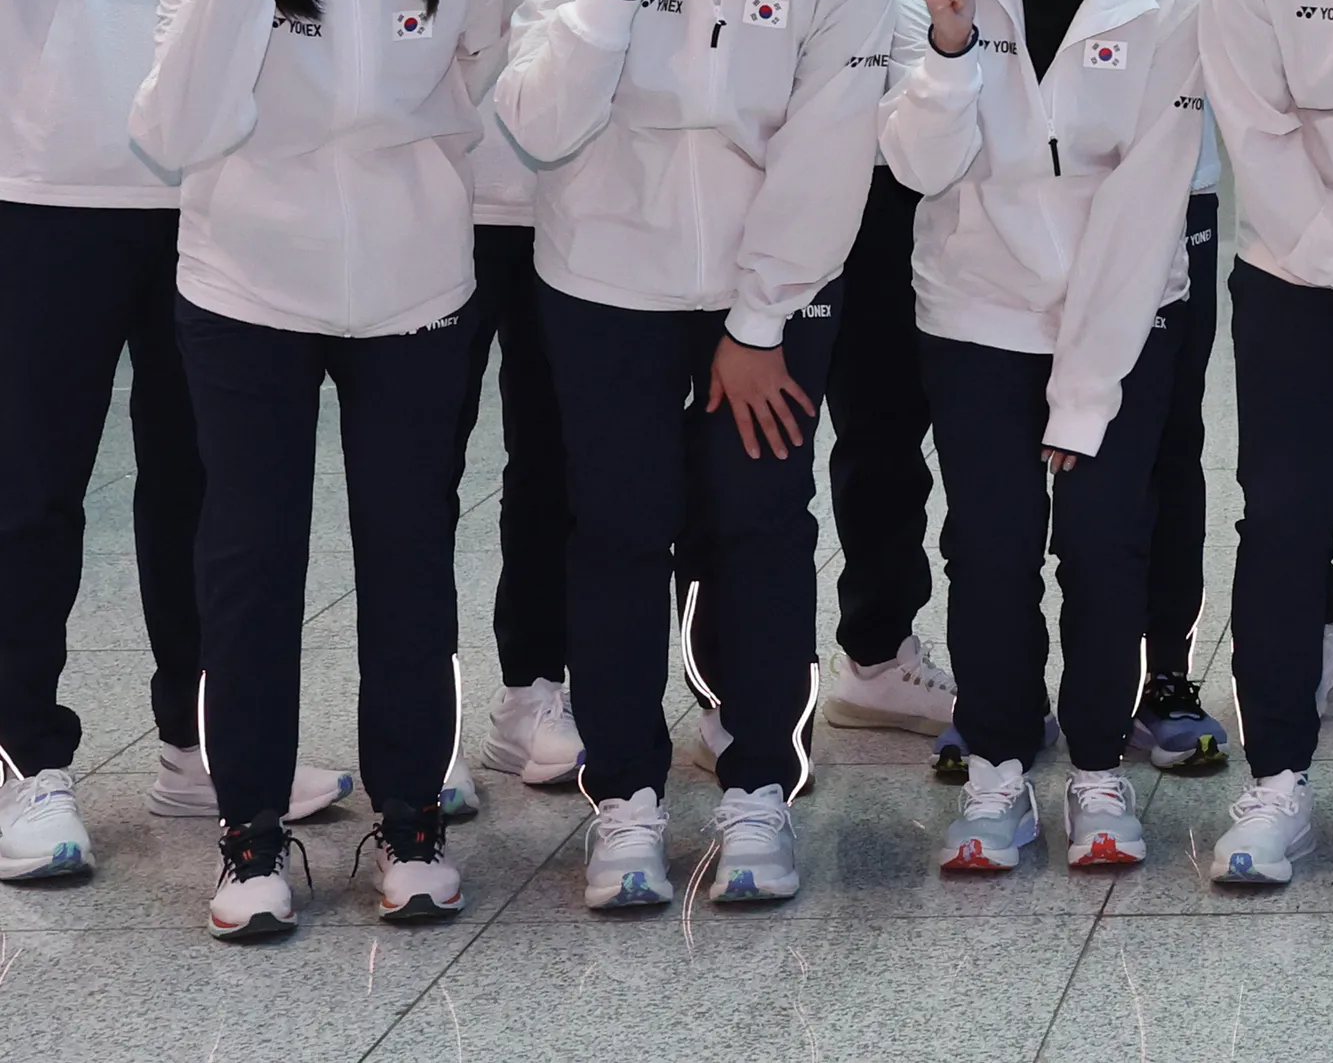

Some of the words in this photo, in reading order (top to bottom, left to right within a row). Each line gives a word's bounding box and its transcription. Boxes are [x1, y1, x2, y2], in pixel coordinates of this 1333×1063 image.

[993, 41, 1017, 55] YOE
[864, 55, 888, 67] YNE
[1191, 229, 1211, 246] YONE
[801, 305, 831, 318] YONEX
